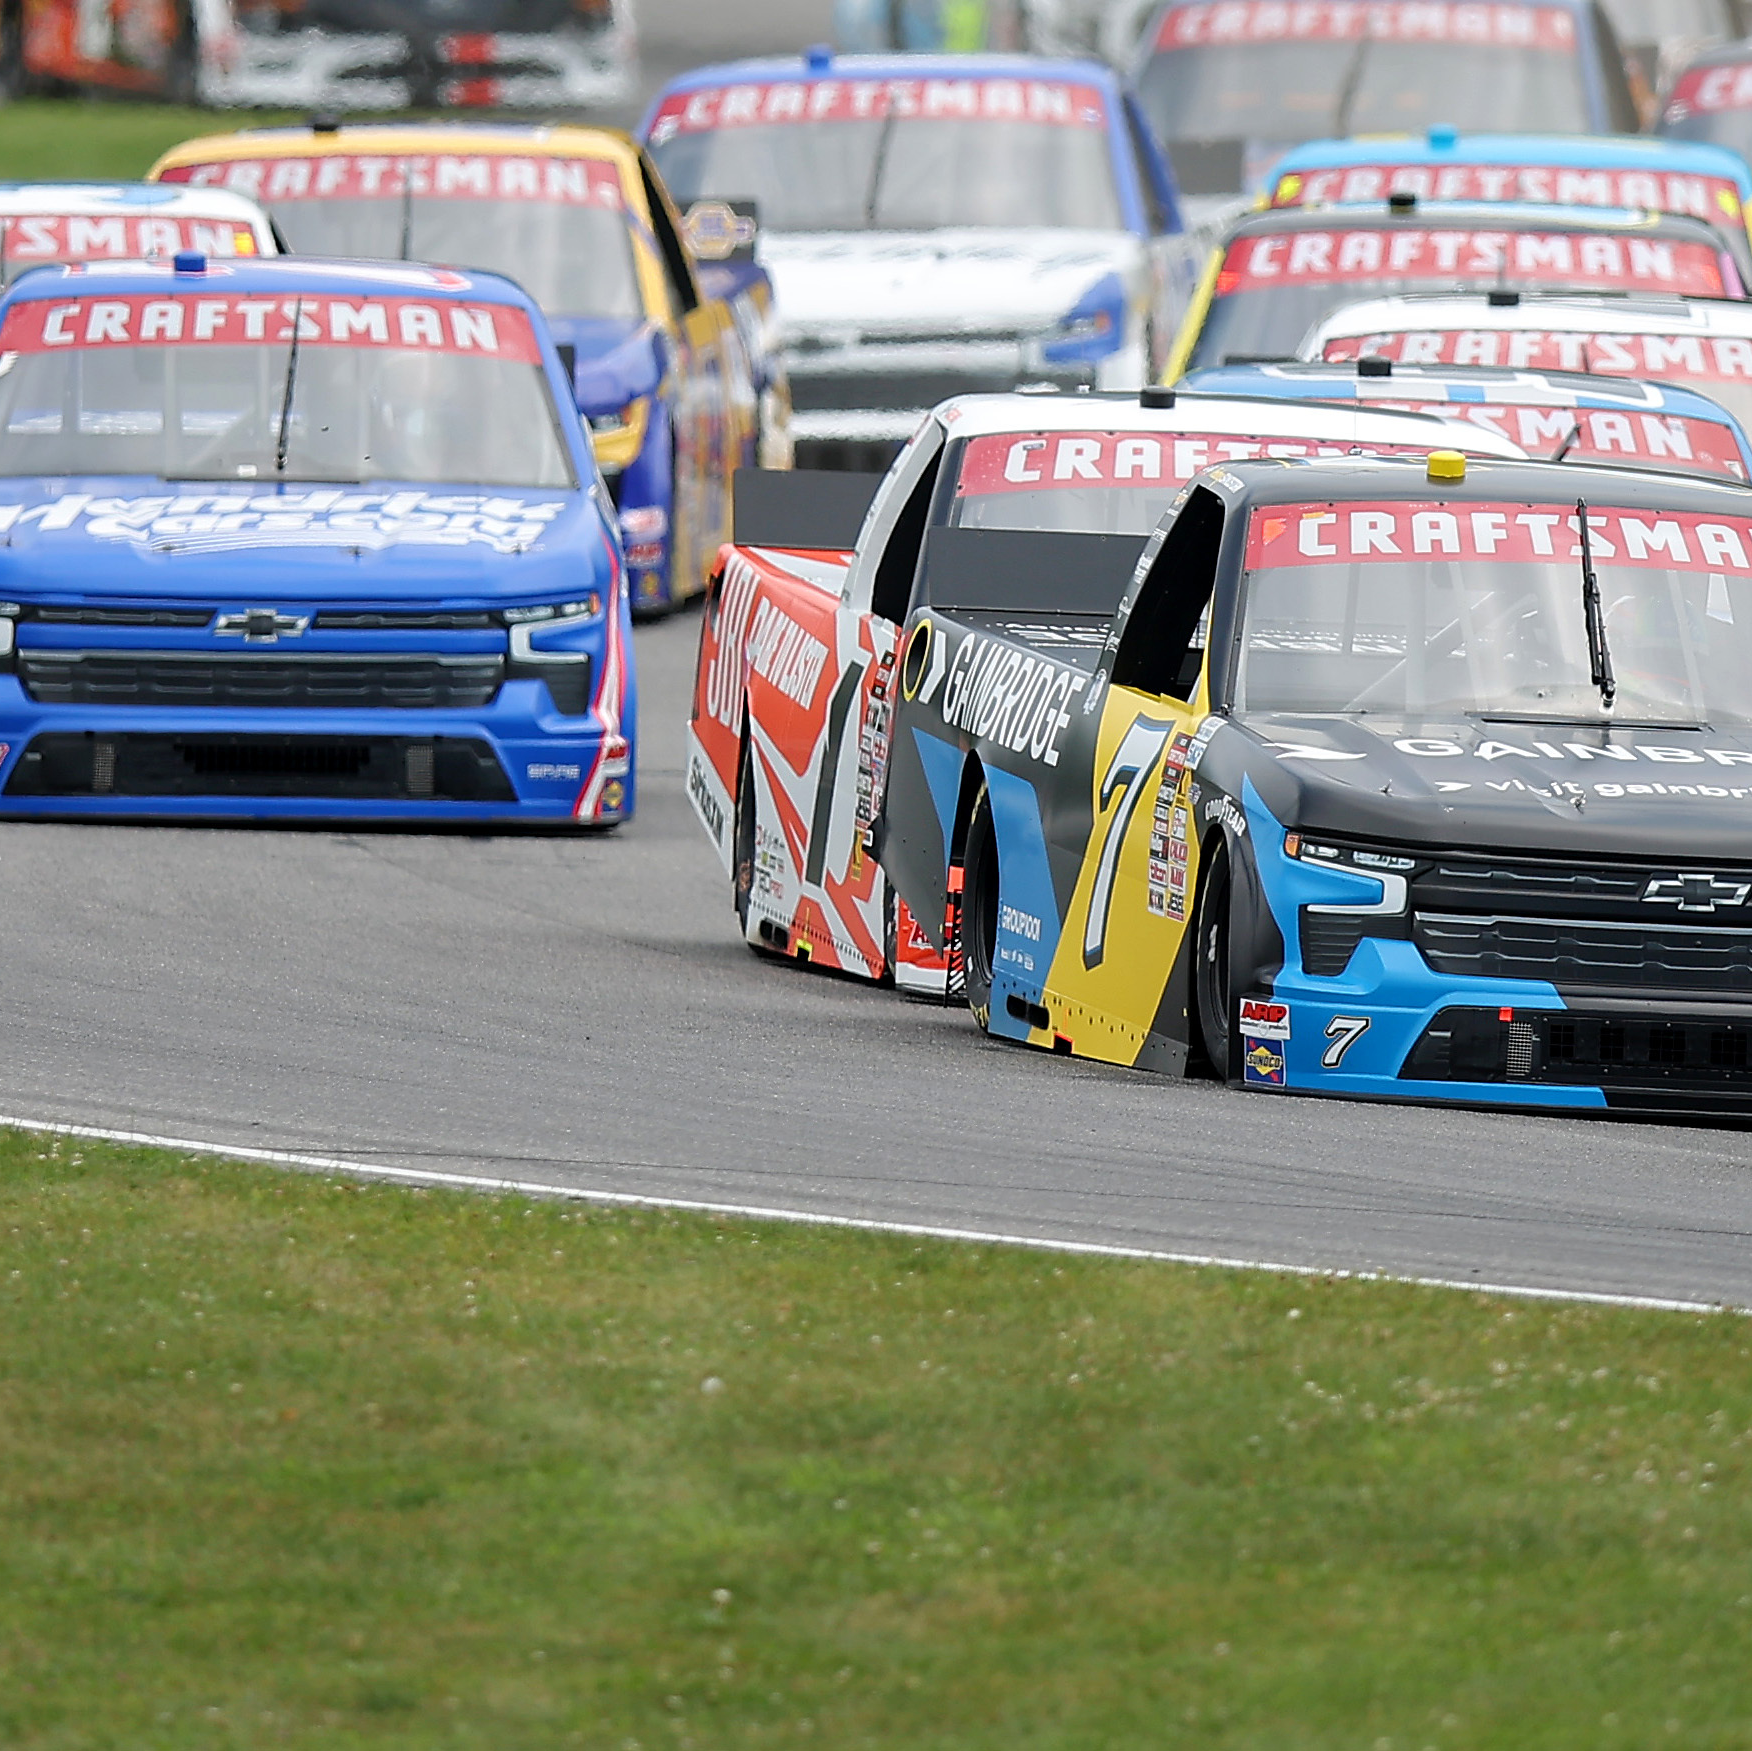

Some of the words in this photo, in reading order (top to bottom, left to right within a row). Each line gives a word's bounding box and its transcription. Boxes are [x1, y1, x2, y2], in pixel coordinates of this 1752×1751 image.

[687, 80, 1072, 125] CRAFTSMAN
[191, 156, 587, 198] CRAFTSMAN
[1303, 167, 1706, 216] CRAFTSMAN
[1250, 231, 1675, 281] CRAFTSMAN
[42, 298, 499, 352] CRAFTSMAN
[942, 632, 1086, 767] GAINBRIDGE
[1205, 794, 1247, 837] GOODYEAR
[1099, 712, 1177, 972] 7
[1240, 1001, 1288, 1023] ARP
[1247, 1052, 1282, 1069] SUNOCO
[1321, 1014, 1371, 1068] 7
